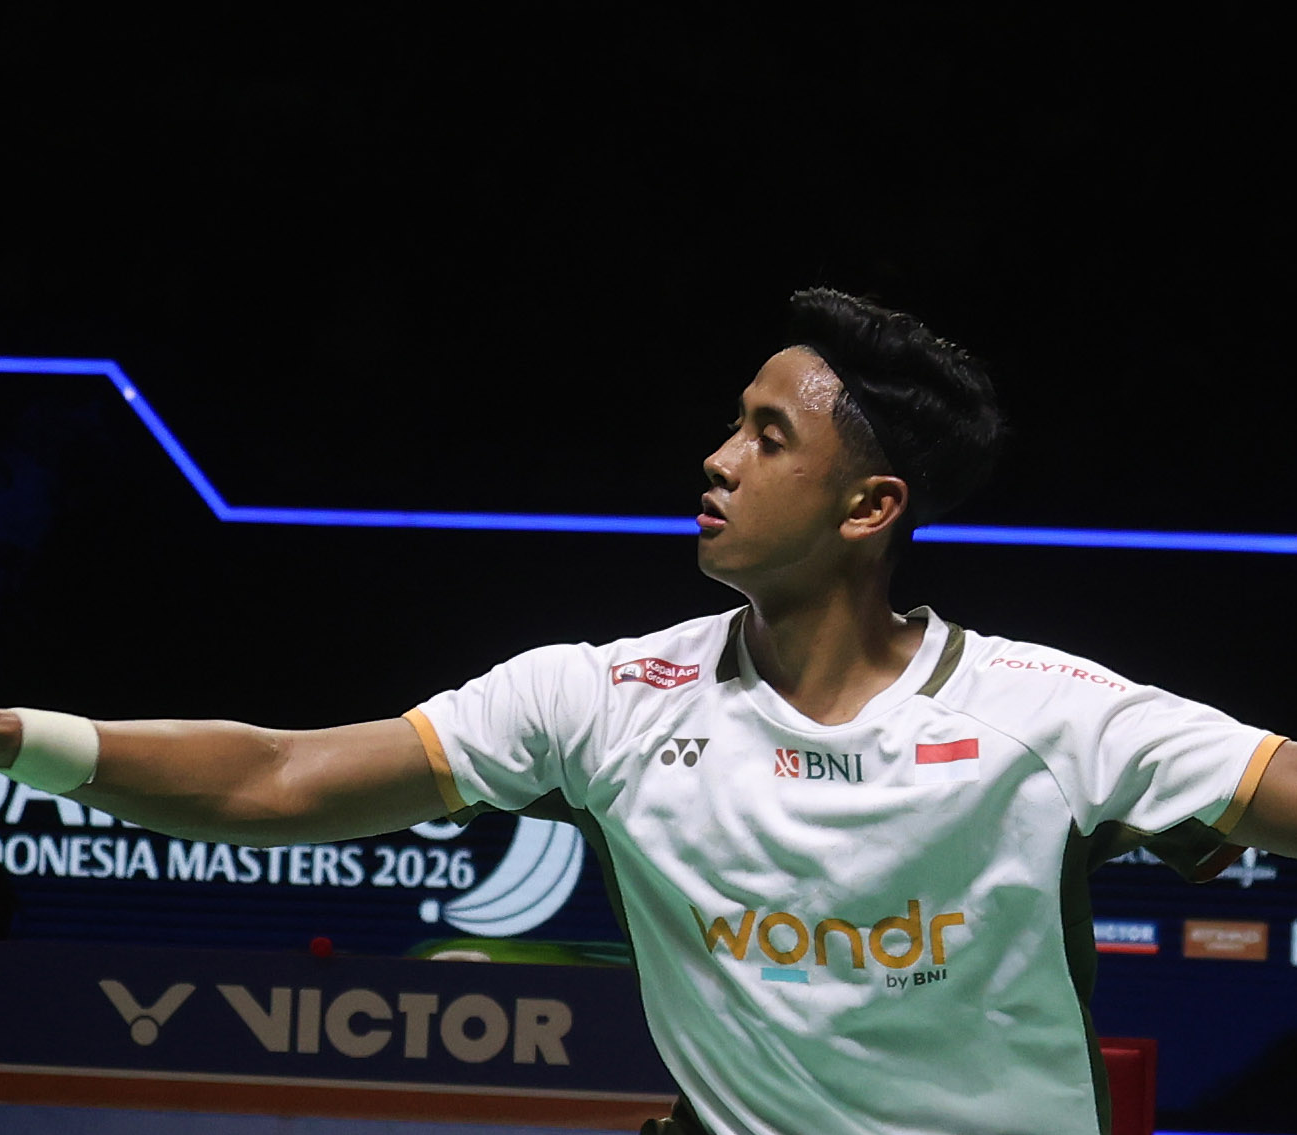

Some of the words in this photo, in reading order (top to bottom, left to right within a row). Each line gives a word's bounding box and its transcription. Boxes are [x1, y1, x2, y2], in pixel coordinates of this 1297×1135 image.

[645, 660, 675, 677] Kapal
[677, 667, 698, 677] Api
[646, 671, 676, 687] Group
[804, 751, 863, 783] BNI
[166, 840, 365, 887] MASTERS
[372, 847, 476, 889] 2026
[689, 899, 965, 969] wondr
[886, 973, 908, 990] by
[913, 969, 948, 986] BNI
[216, 984, 573, 1066] VICTOR
